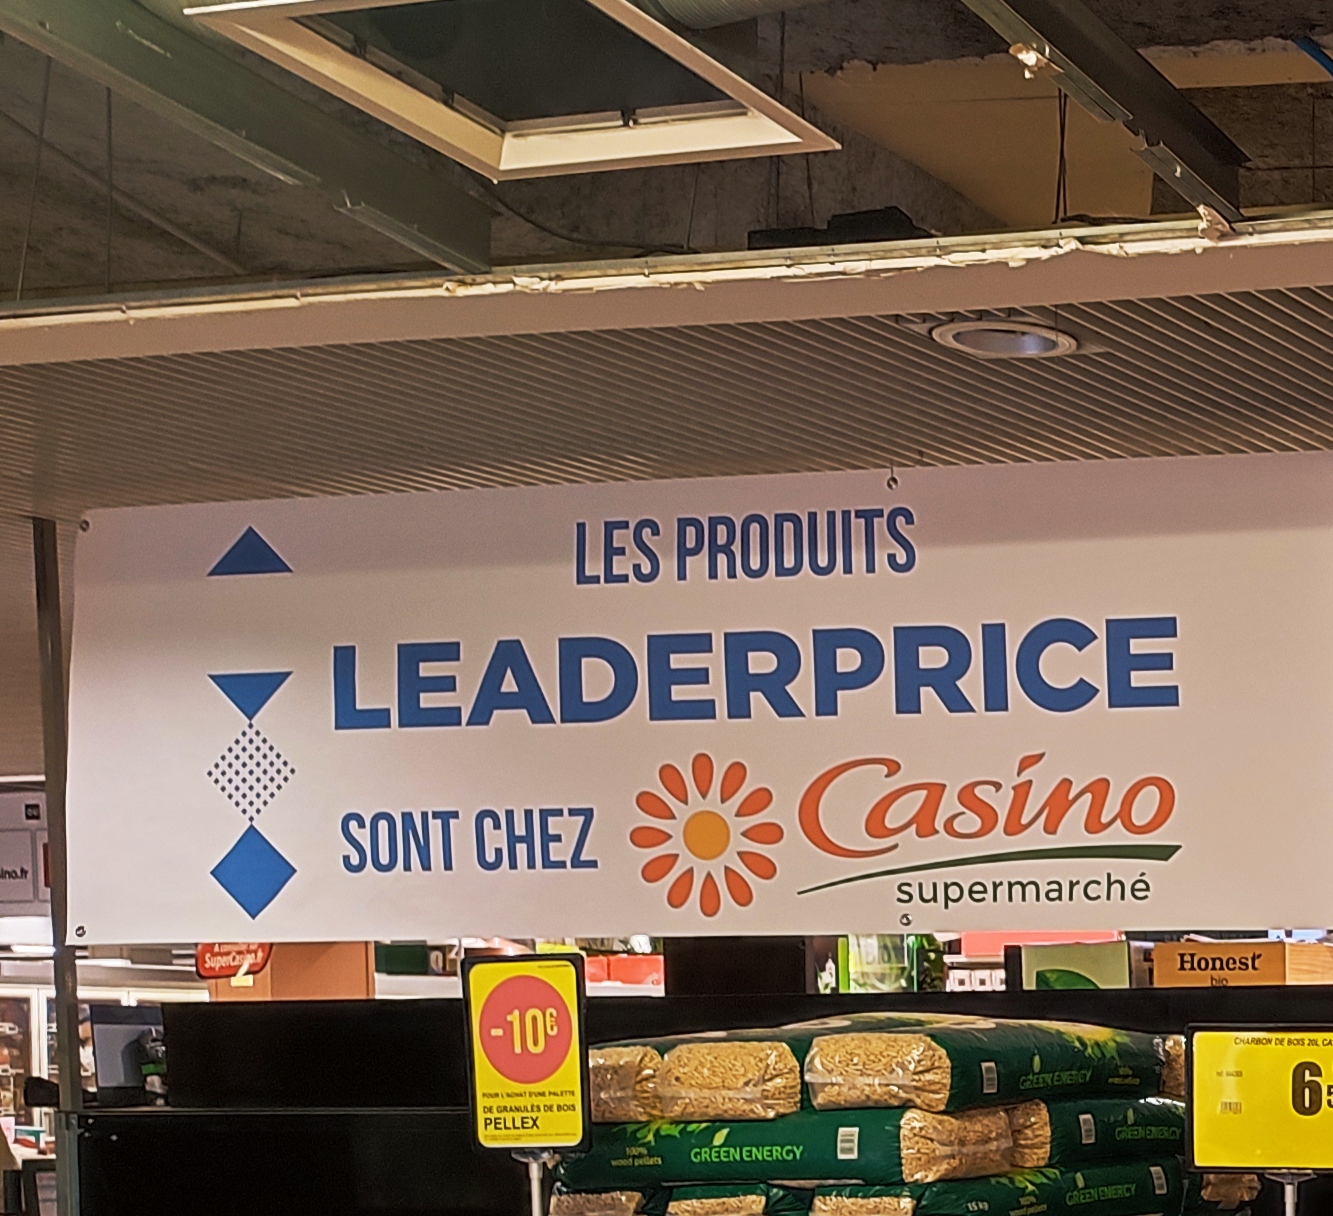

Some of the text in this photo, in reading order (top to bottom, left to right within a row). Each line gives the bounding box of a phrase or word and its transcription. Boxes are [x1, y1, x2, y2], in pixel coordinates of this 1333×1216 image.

[576, 506, 917, 585] LES PRODUITS
[333, 615, 1181, 731] LEADERPRICE
[799, 750, 1179, 860] Casino
[341, 807, 599, 873] SONT CHEZ
[895, 874, 1152, 908] supermarché
[1177, 952, 1262, 973] Honest
[1234, 1037, 1273, 1046] CHARBON
[1275, 1037, 1285, 1046] DE
[1291, 1060, 1323, 1116] 6
[483, 1103, 576, 1114] DE GRANULÉS DE BOIS
[484, 1116, 539, 1131] PELLEX
[690, 1145, 803, 1162] GREEN ENERGY
